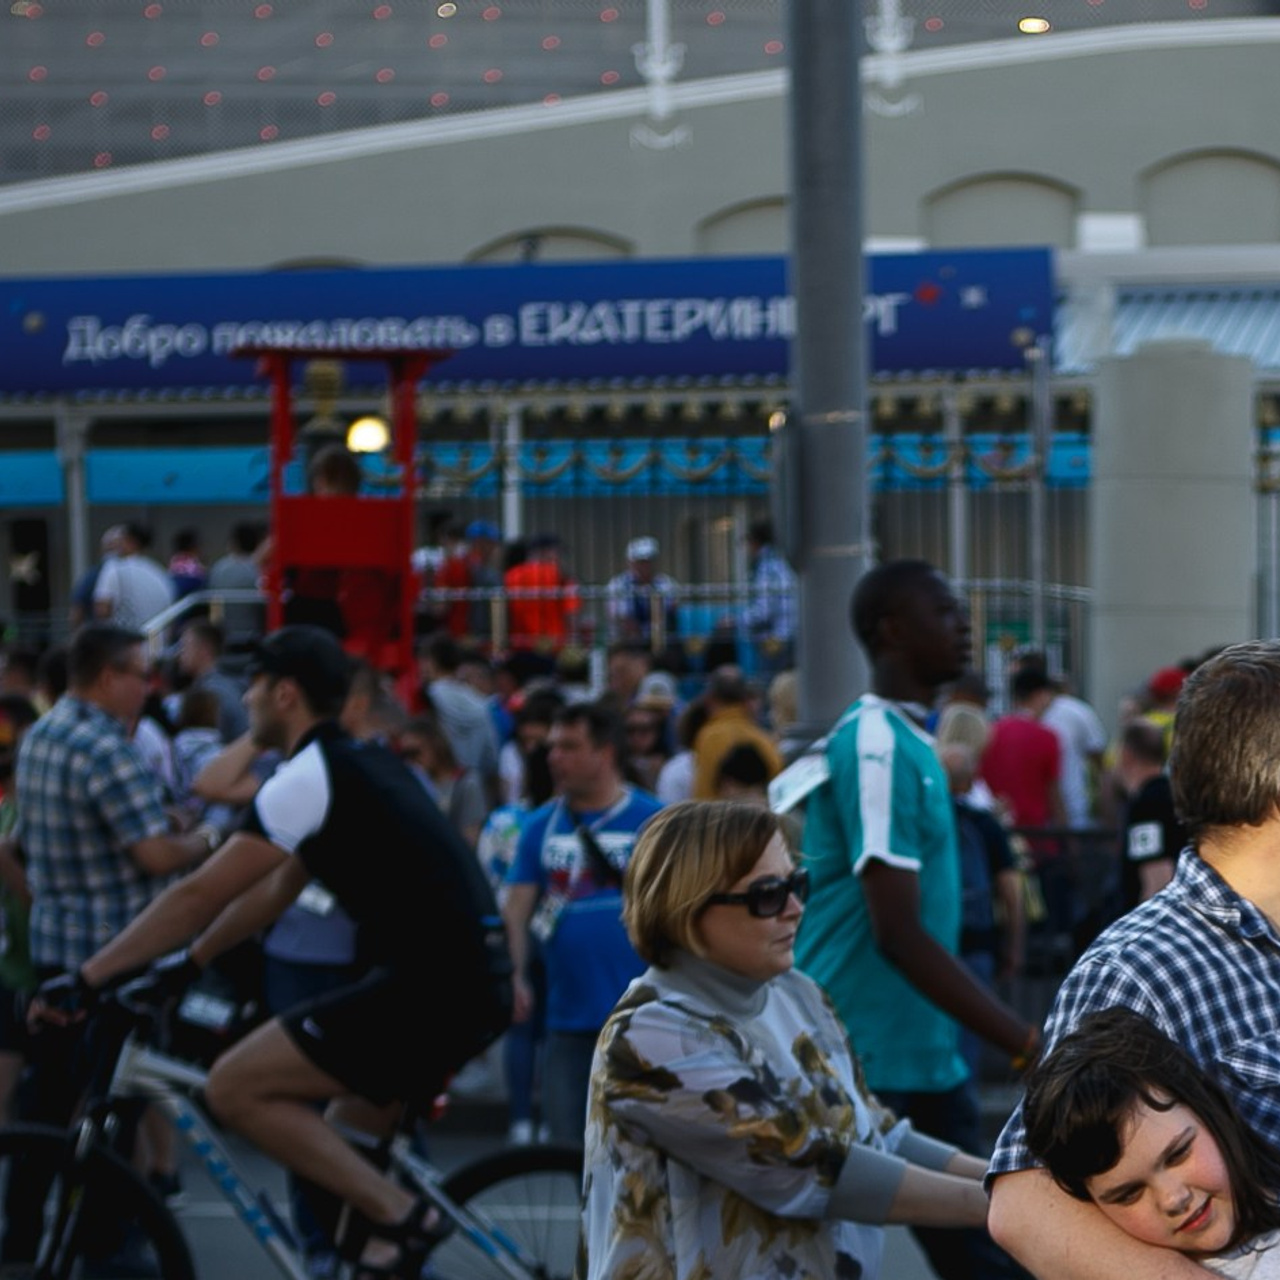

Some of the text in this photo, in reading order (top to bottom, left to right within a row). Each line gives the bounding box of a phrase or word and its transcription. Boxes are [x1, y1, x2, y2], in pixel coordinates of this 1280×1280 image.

[64, 295, 909, 366] Добро пожаловать в ЕКАТЕРИНГ
